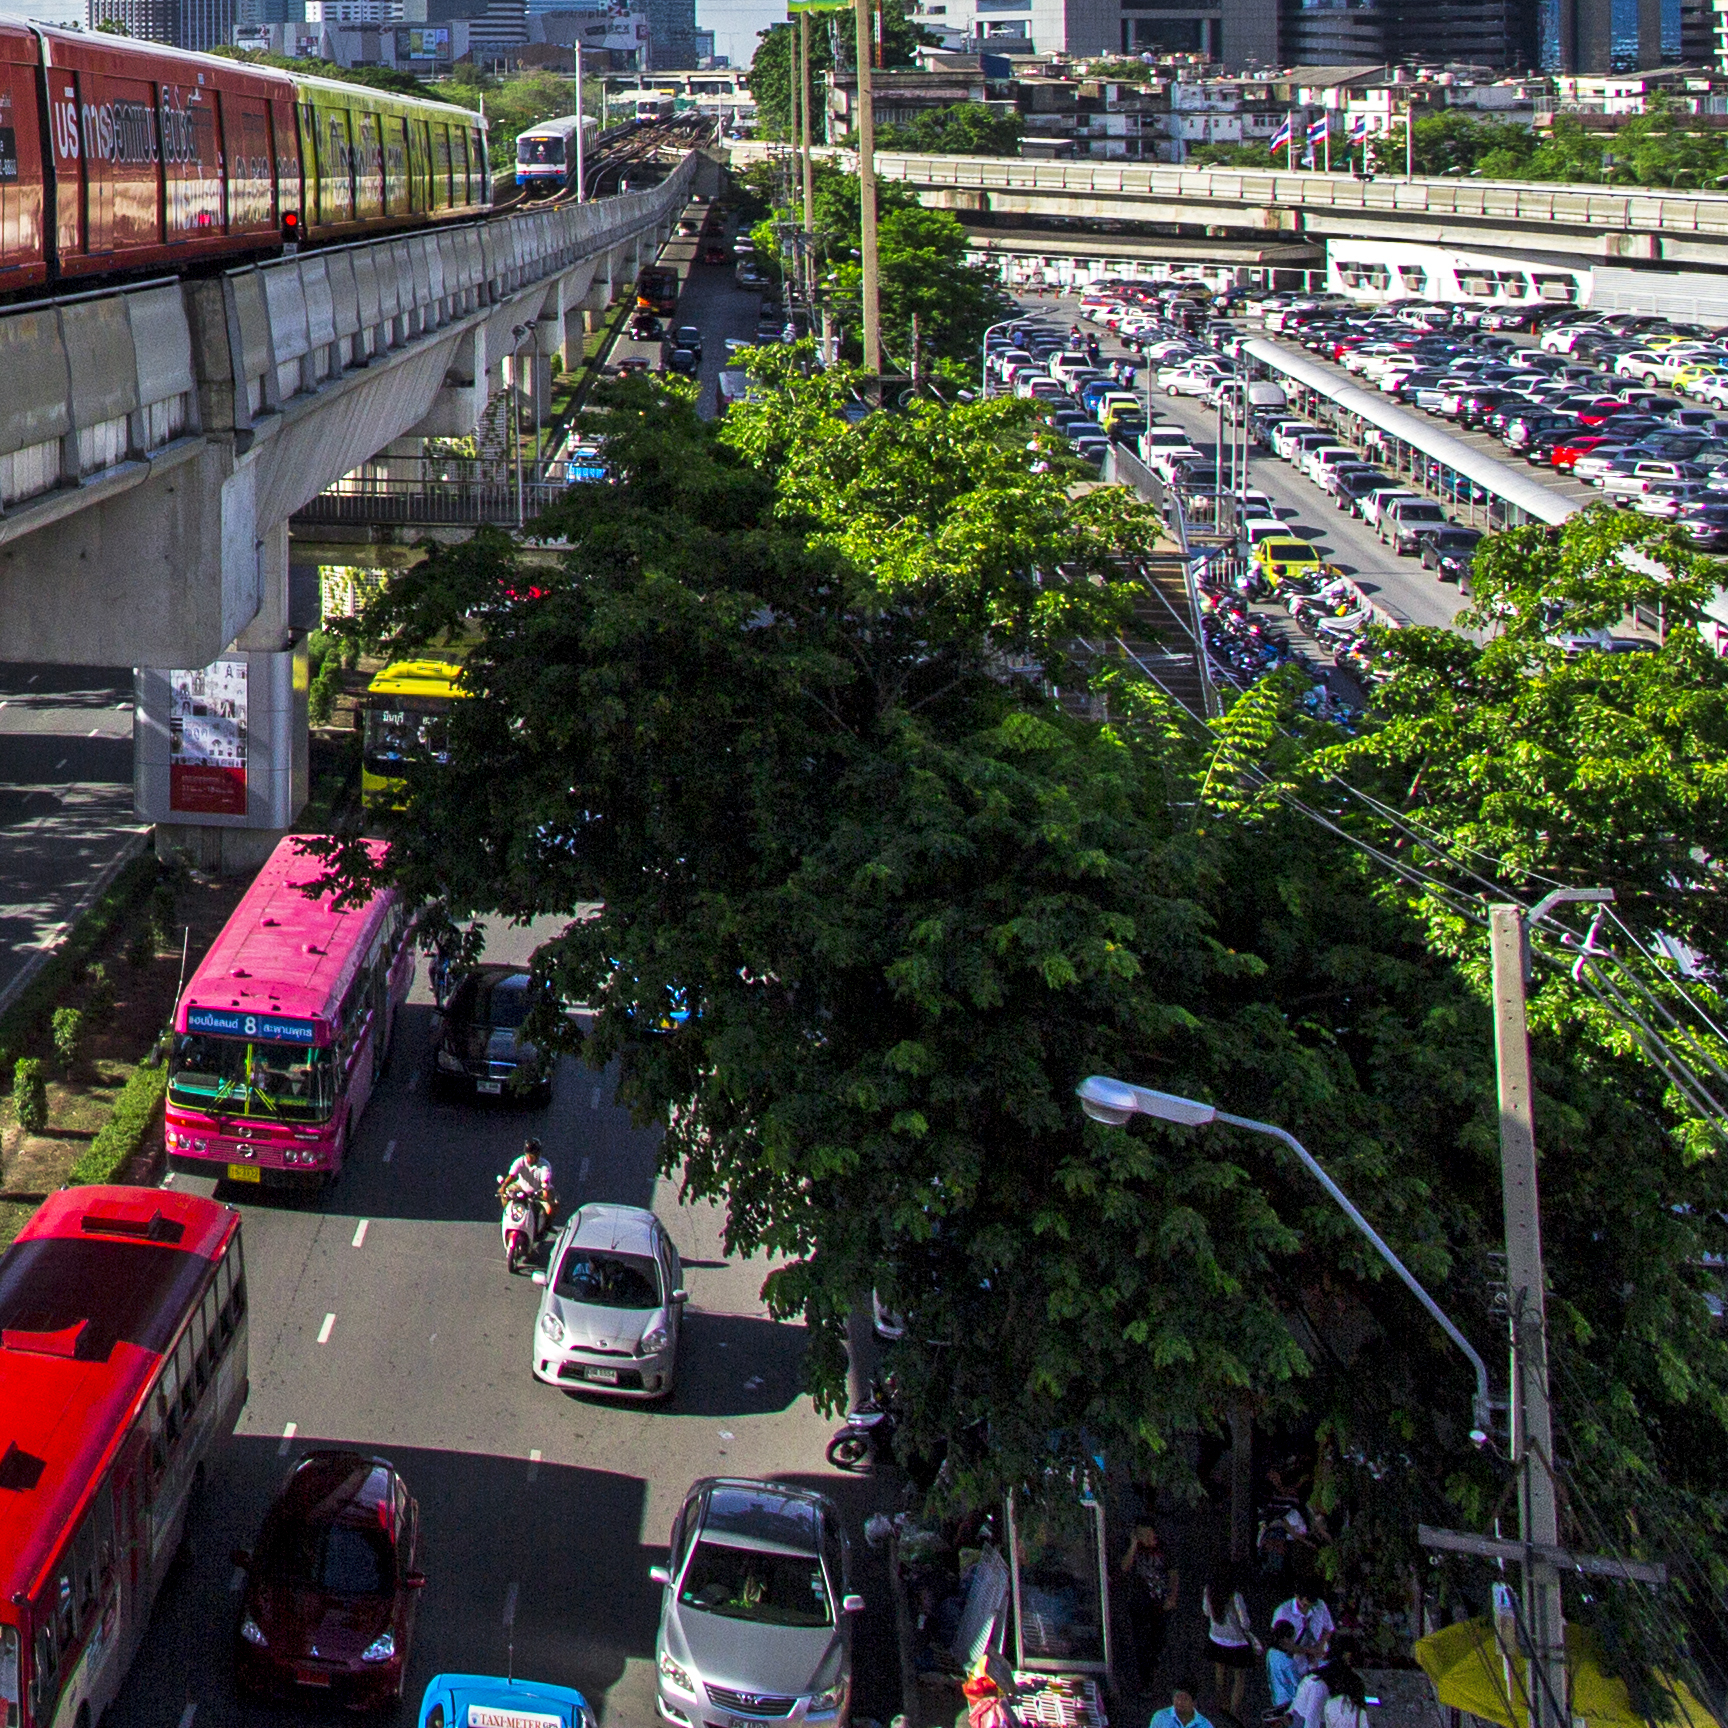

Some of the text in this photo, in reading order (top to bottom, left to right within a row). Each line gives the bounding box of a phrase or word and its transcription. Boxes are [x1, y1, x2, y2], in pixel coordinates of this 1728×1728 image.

[244, 1016, 257, 1035] 8
[263, 1023, 313, 1038] สะพานพุทธ
